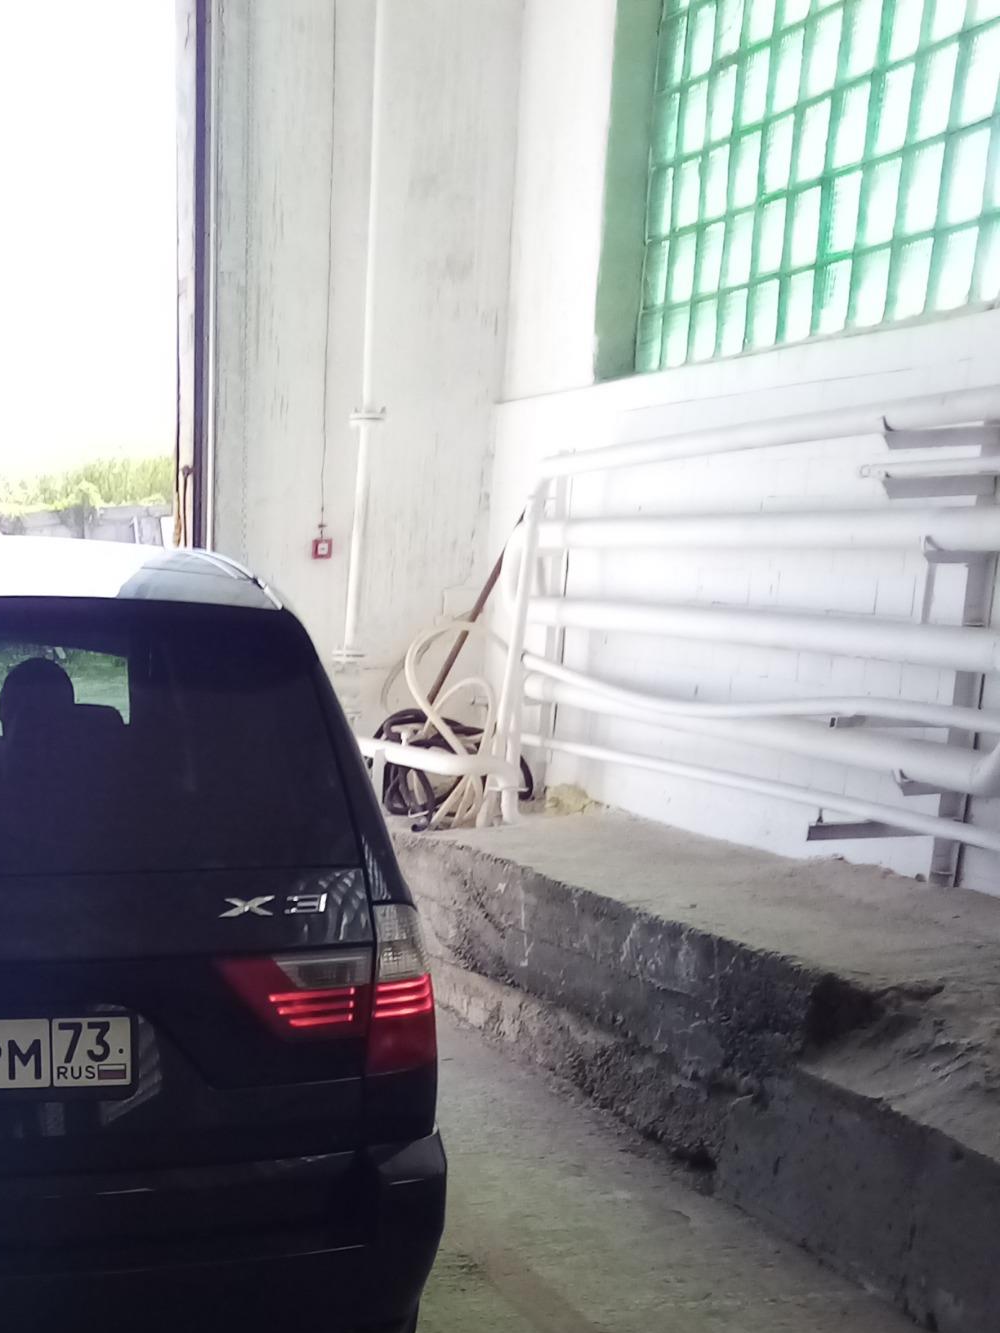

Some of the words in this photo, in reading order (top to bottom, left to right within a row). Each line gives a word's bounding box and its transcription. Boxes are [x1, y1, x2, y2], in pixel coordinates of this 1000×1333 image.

[218, 894, 327, 918] X3
[57, 1020, 111, 1064] 73
[56, 1065, 96, 1081] RUS
